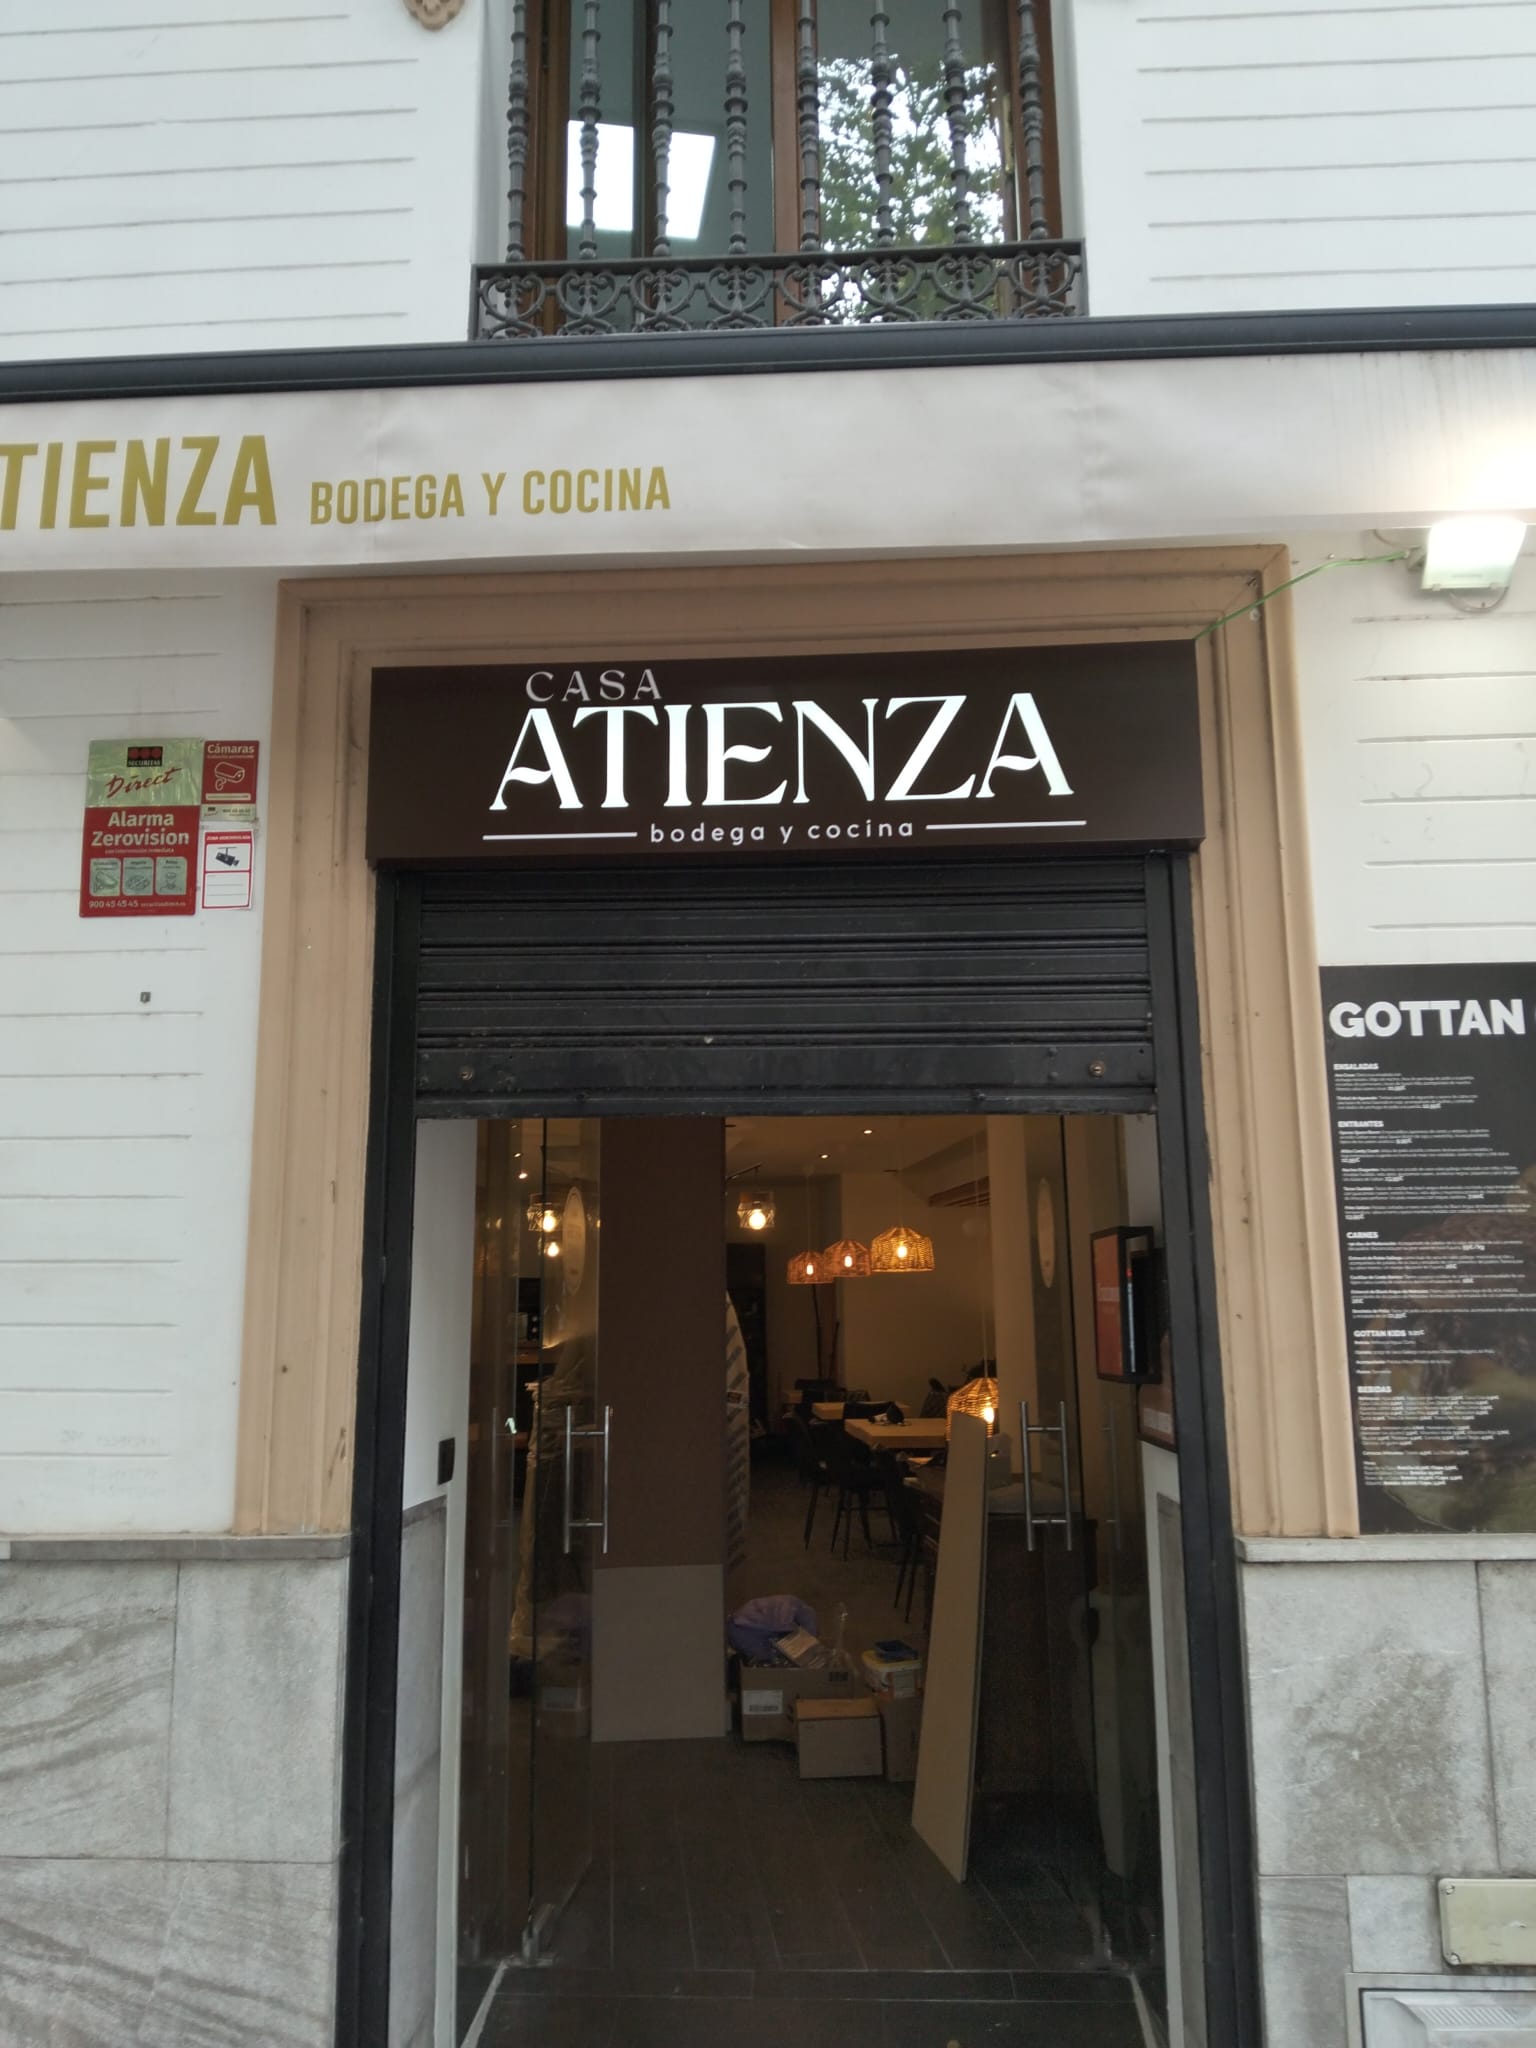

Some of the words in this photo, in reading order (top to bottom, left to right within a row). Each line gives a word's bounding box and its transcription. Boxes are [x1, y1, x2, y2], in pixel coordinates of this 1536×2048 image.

[310, 473, 465, 525] BODEGA
[482, 472, 507, 516] Y
[522, 466, 671, 515] COCINA
[525, 668, 663, 703] CASA
[207, 744, 255, 754] Cámaras
[489, 692, 1074, 811] ATIENZA
[105, 767, 182, 798] Direct
[108, 811, 174, 827] Alarma
[650, 822, 765, 846] bodega
[780, 825, 794, 845] y
[807, 818, 914, 840] cocina
[91, 828, 189, 847] Zerovision
[1329, 998, 1526, 1038] GOTTAN
